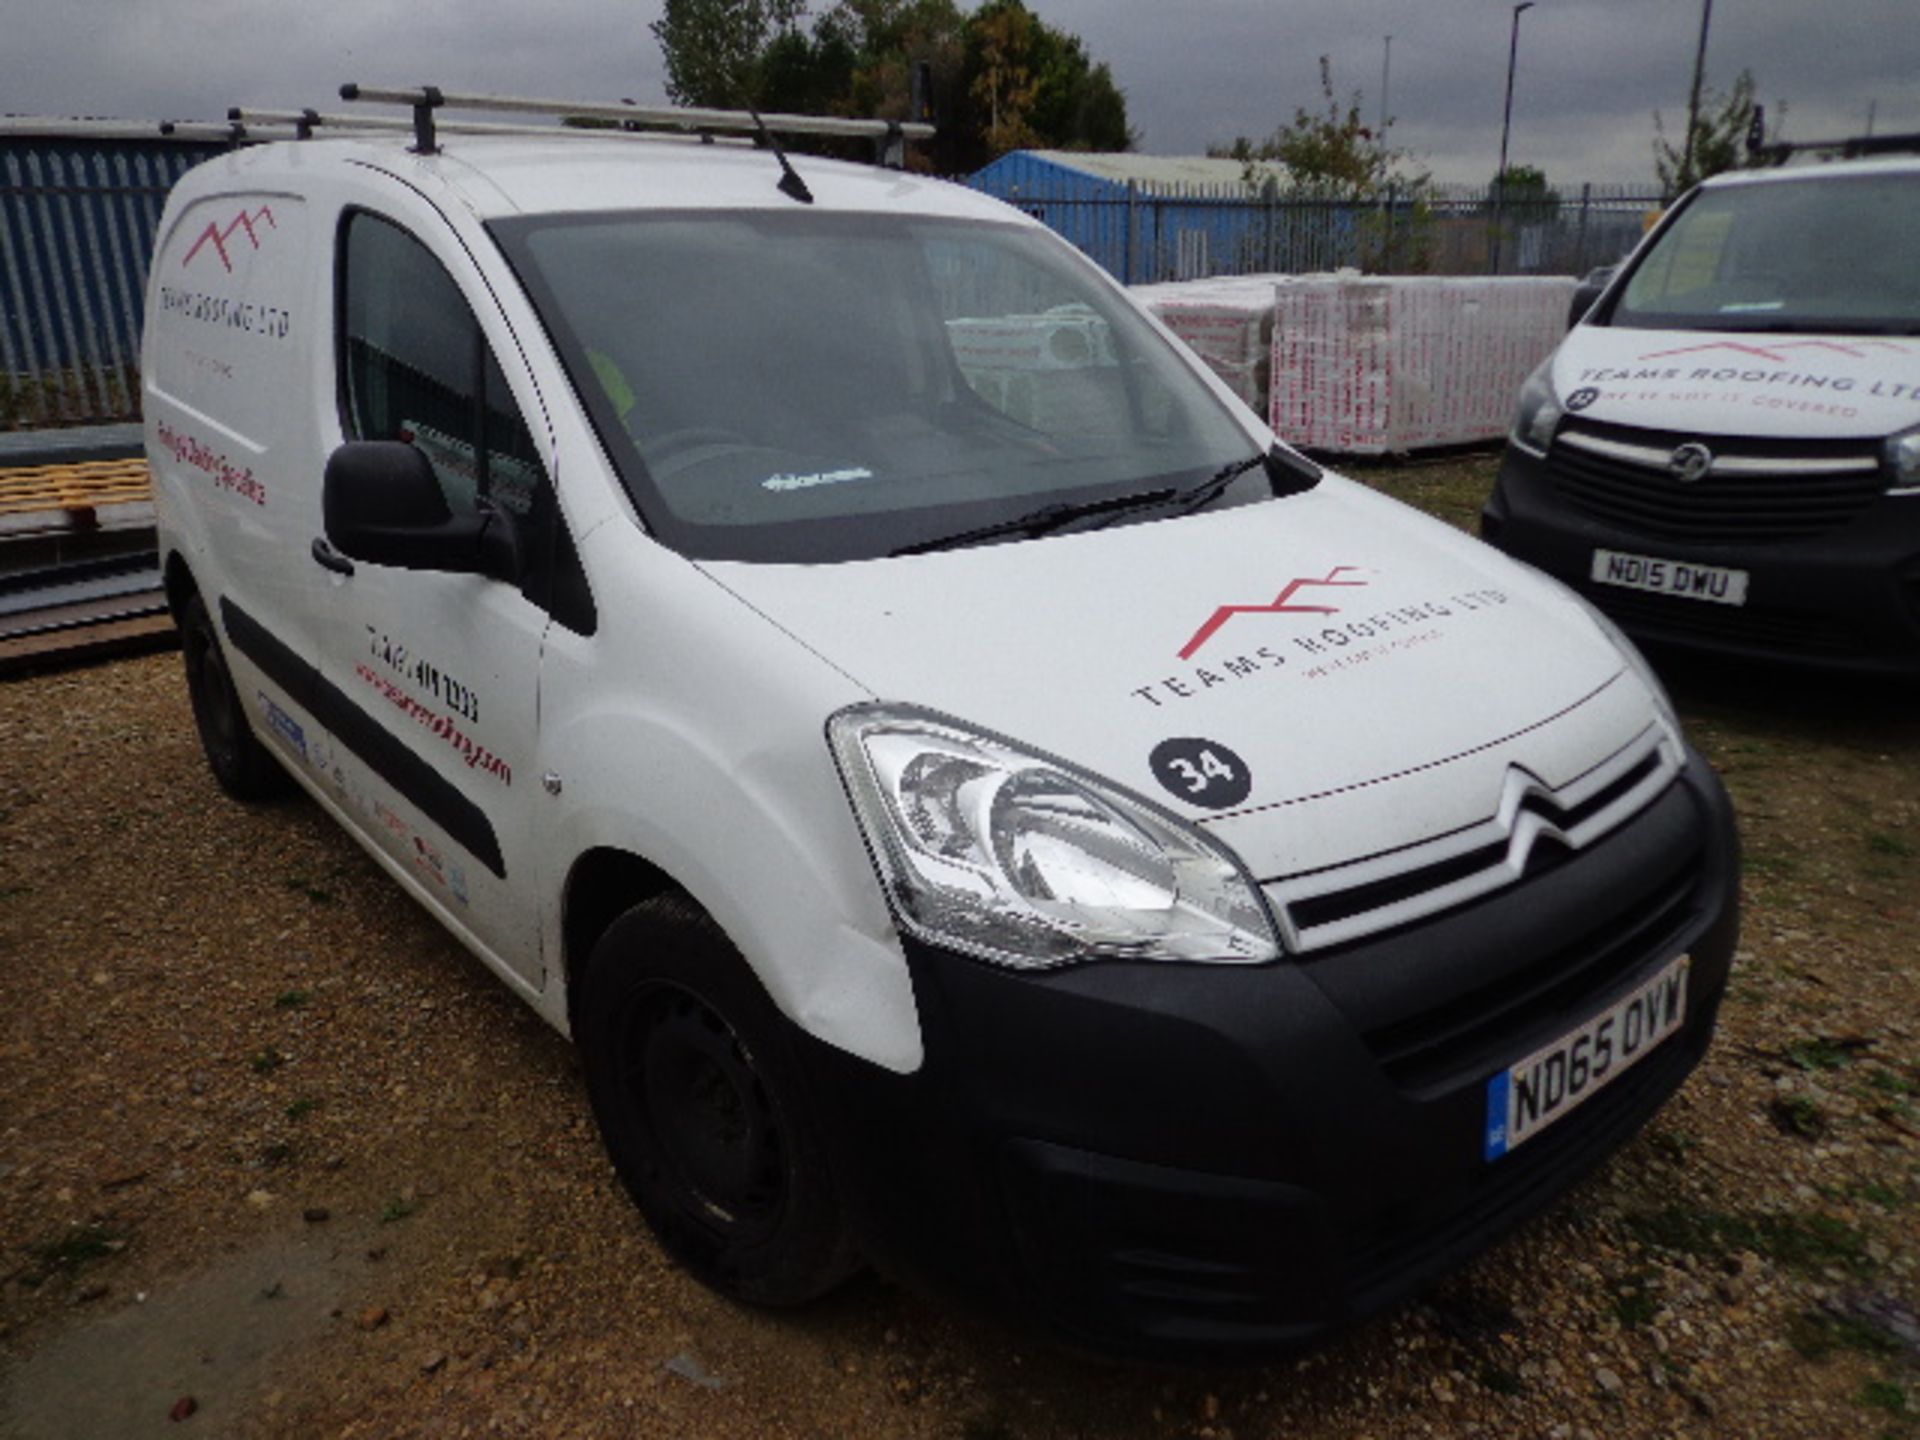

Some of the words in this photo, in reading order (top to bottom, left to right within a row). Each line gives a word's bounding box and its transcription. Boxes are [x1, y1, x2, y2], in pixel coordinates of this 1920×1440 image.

[1578, 367, 1681, 382] TEAMS
[1687, 367, 1857, 392] ROOFING
[1752, 394, 1858, 418] COVERED
[1607, 554, 1667, 588] ND15
[1130, 646, 1286, 707] TEAMS
[1292, 601, 1453, 655] ROOFING
[1452, 589, 1509, 611] LTD
[1168, 748, 1235, 793] 34
[1515, 1016, 1616, 1132] ND65
